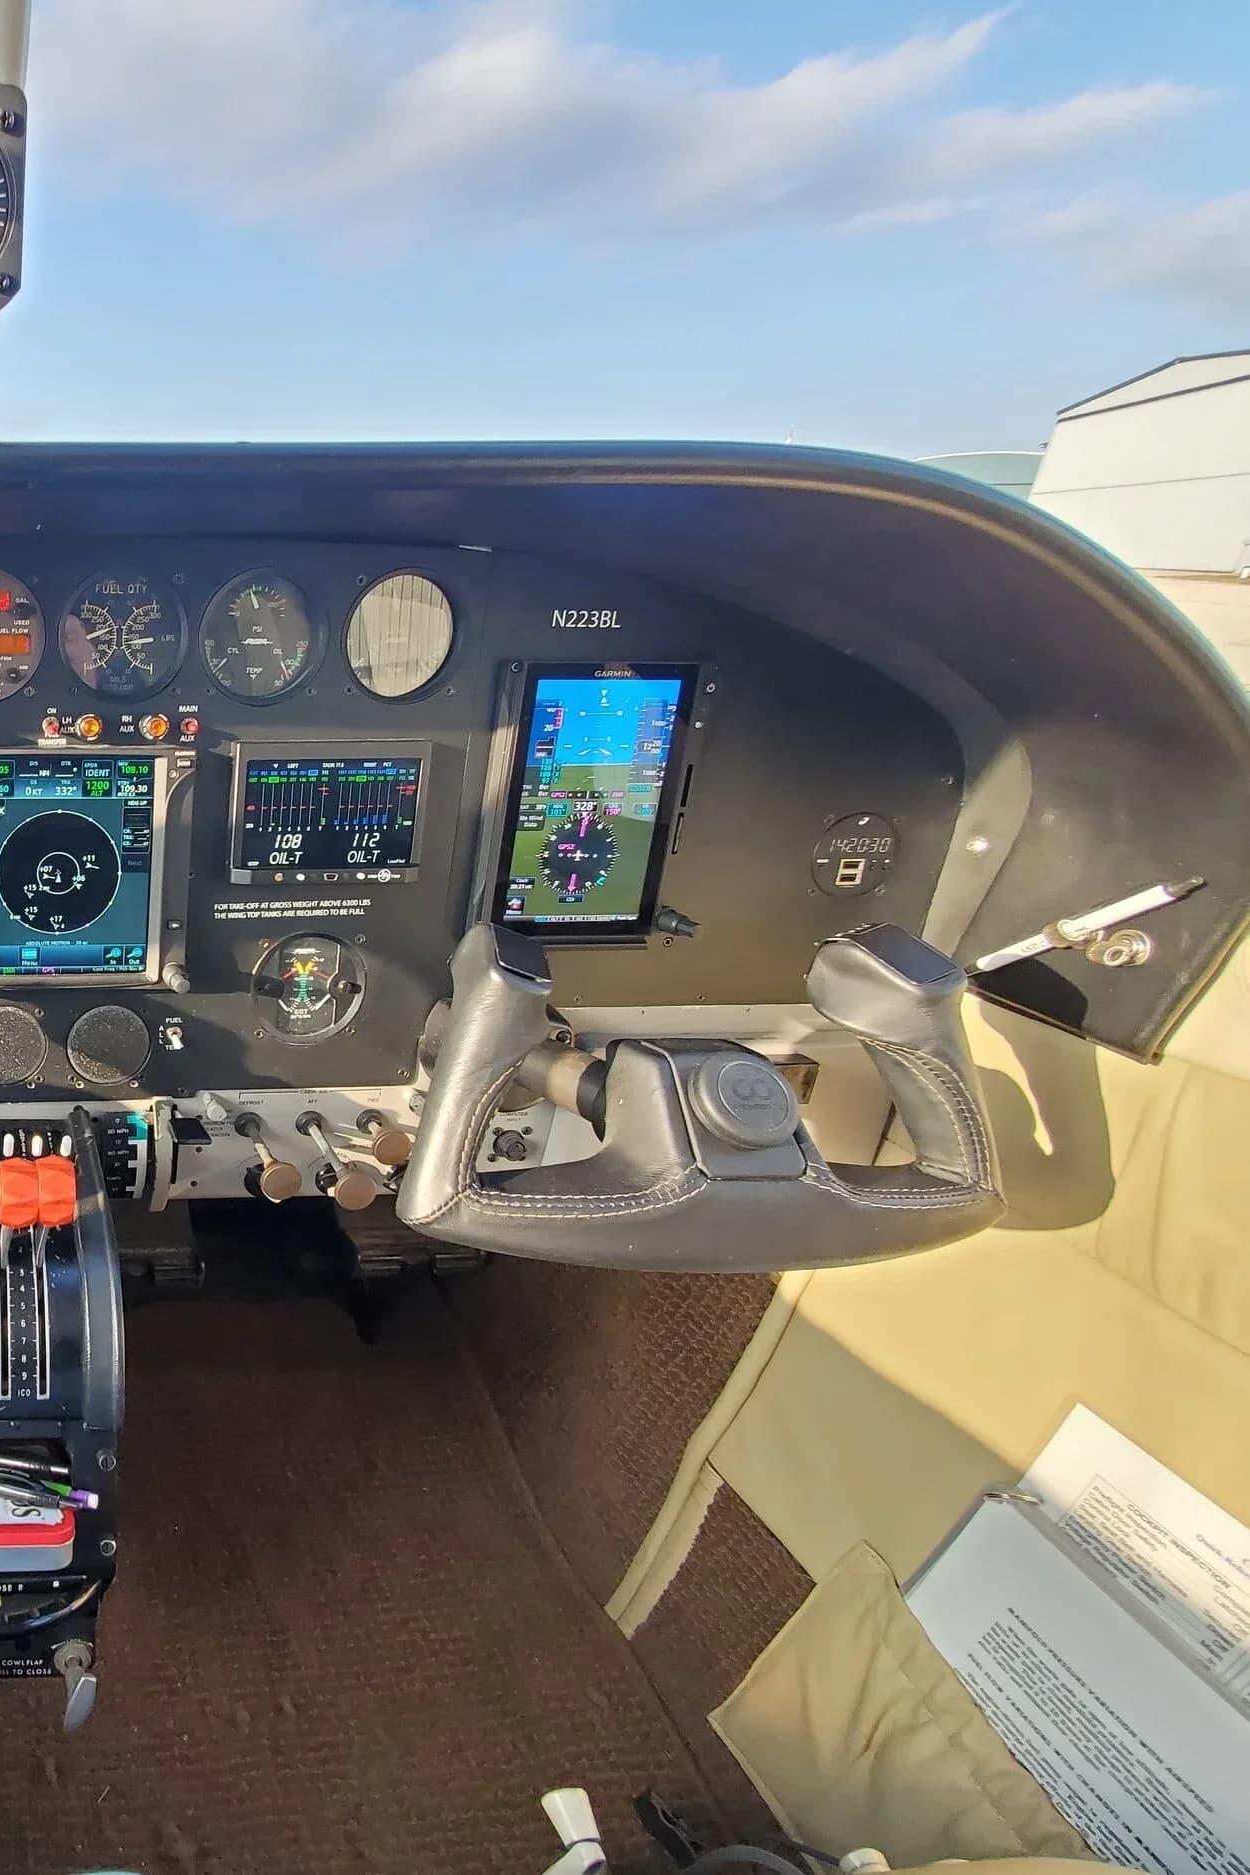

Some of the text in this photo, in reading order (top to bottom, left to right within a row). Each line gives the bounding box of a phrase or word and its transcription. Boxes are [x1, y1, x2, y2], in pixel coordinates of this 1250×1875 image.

[95, 583, 148, 594] FUEL QTY
[551, 609, 621, 629] N223BL
[594, 670, 631, 678] GARMIN
[179, 705, 198, 713] MAIN
[180, 734, 196, 742] AUX
[86, 769, 110, 777] IDENT
[86, 781, 109, 790] 1200
[275, 834, 302, 848] 108
[352, 833, 380, 847] 112
[829, 836, 892, 854] 14:20:30
[269, 852, 303, 864] OIL-T
[347, 850, 381, 863] OIL-T
[229, 902, 259, 910] TAKE-OFF
[270, 901, 292, 909] GROSS
[293, 901, 318, 909] WEIGHT
[319, 900, 341, 908] ABOVE
[297, 909, 329, 917] REQUIRED
[19, 1269, 25, 1277] 3
[20, 1285, 25, 1293] 4
[20, 1302, 26, 1310] 5
[20, 1320, 26, 1328] 6
[21, 1337, 27, 1345] 7
[21, 1354, 27, 1363] 8
[22, 1372, 28, 1380] 9
[1127, 1503, 1231, 1588] COCKPIT INSPECTION
[1, 1659, 25, 1667] COWL
